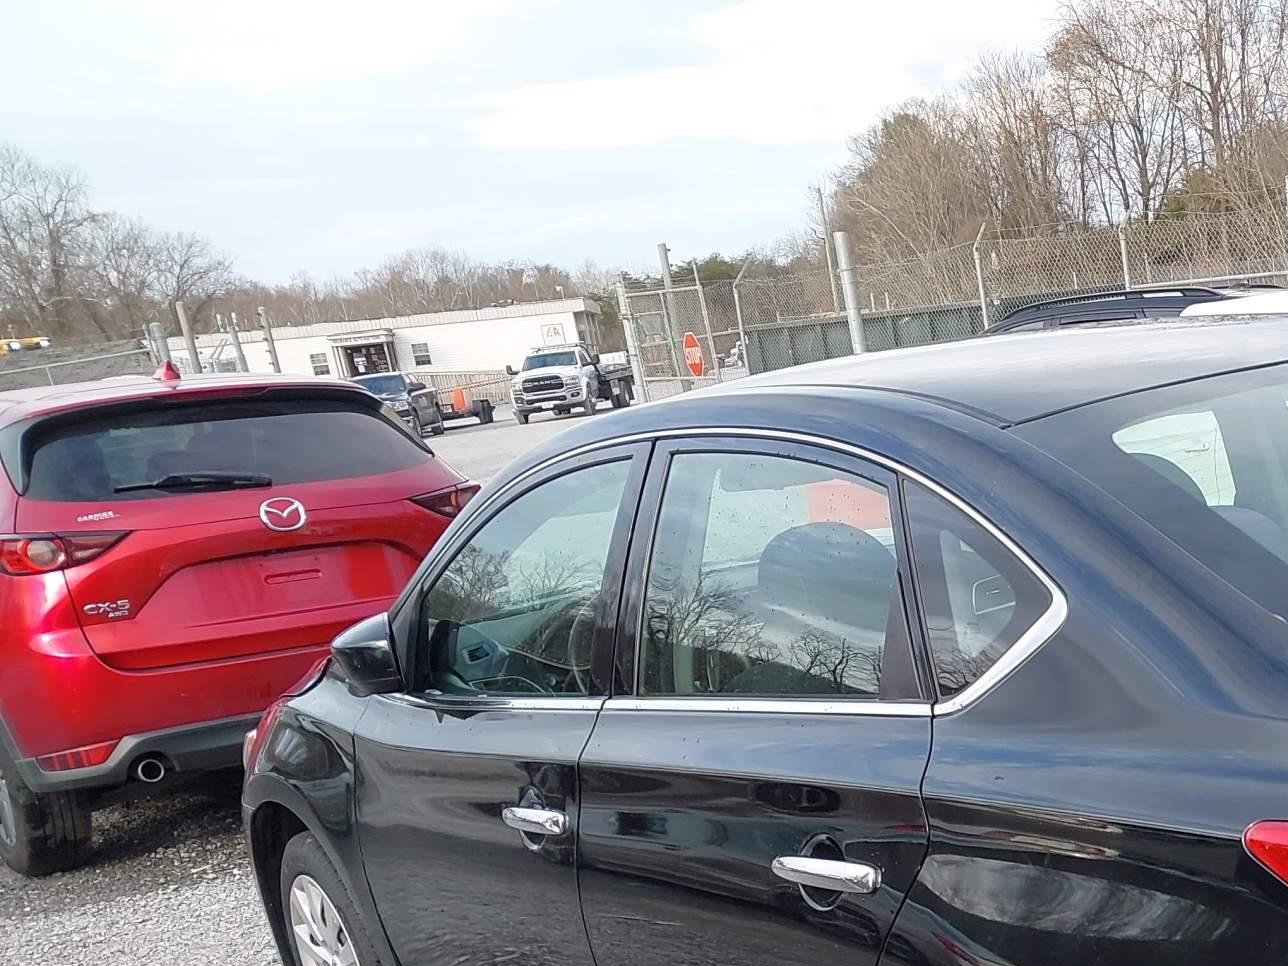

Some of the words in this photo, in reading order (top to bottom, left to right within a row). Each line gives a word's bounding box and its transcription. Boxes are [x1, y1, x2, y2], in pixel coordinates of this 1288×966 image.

[686, 347, 701, 364] STOP
[83, 599, 130, 614] CX-5
[108, 610, 129, 618] AWD
